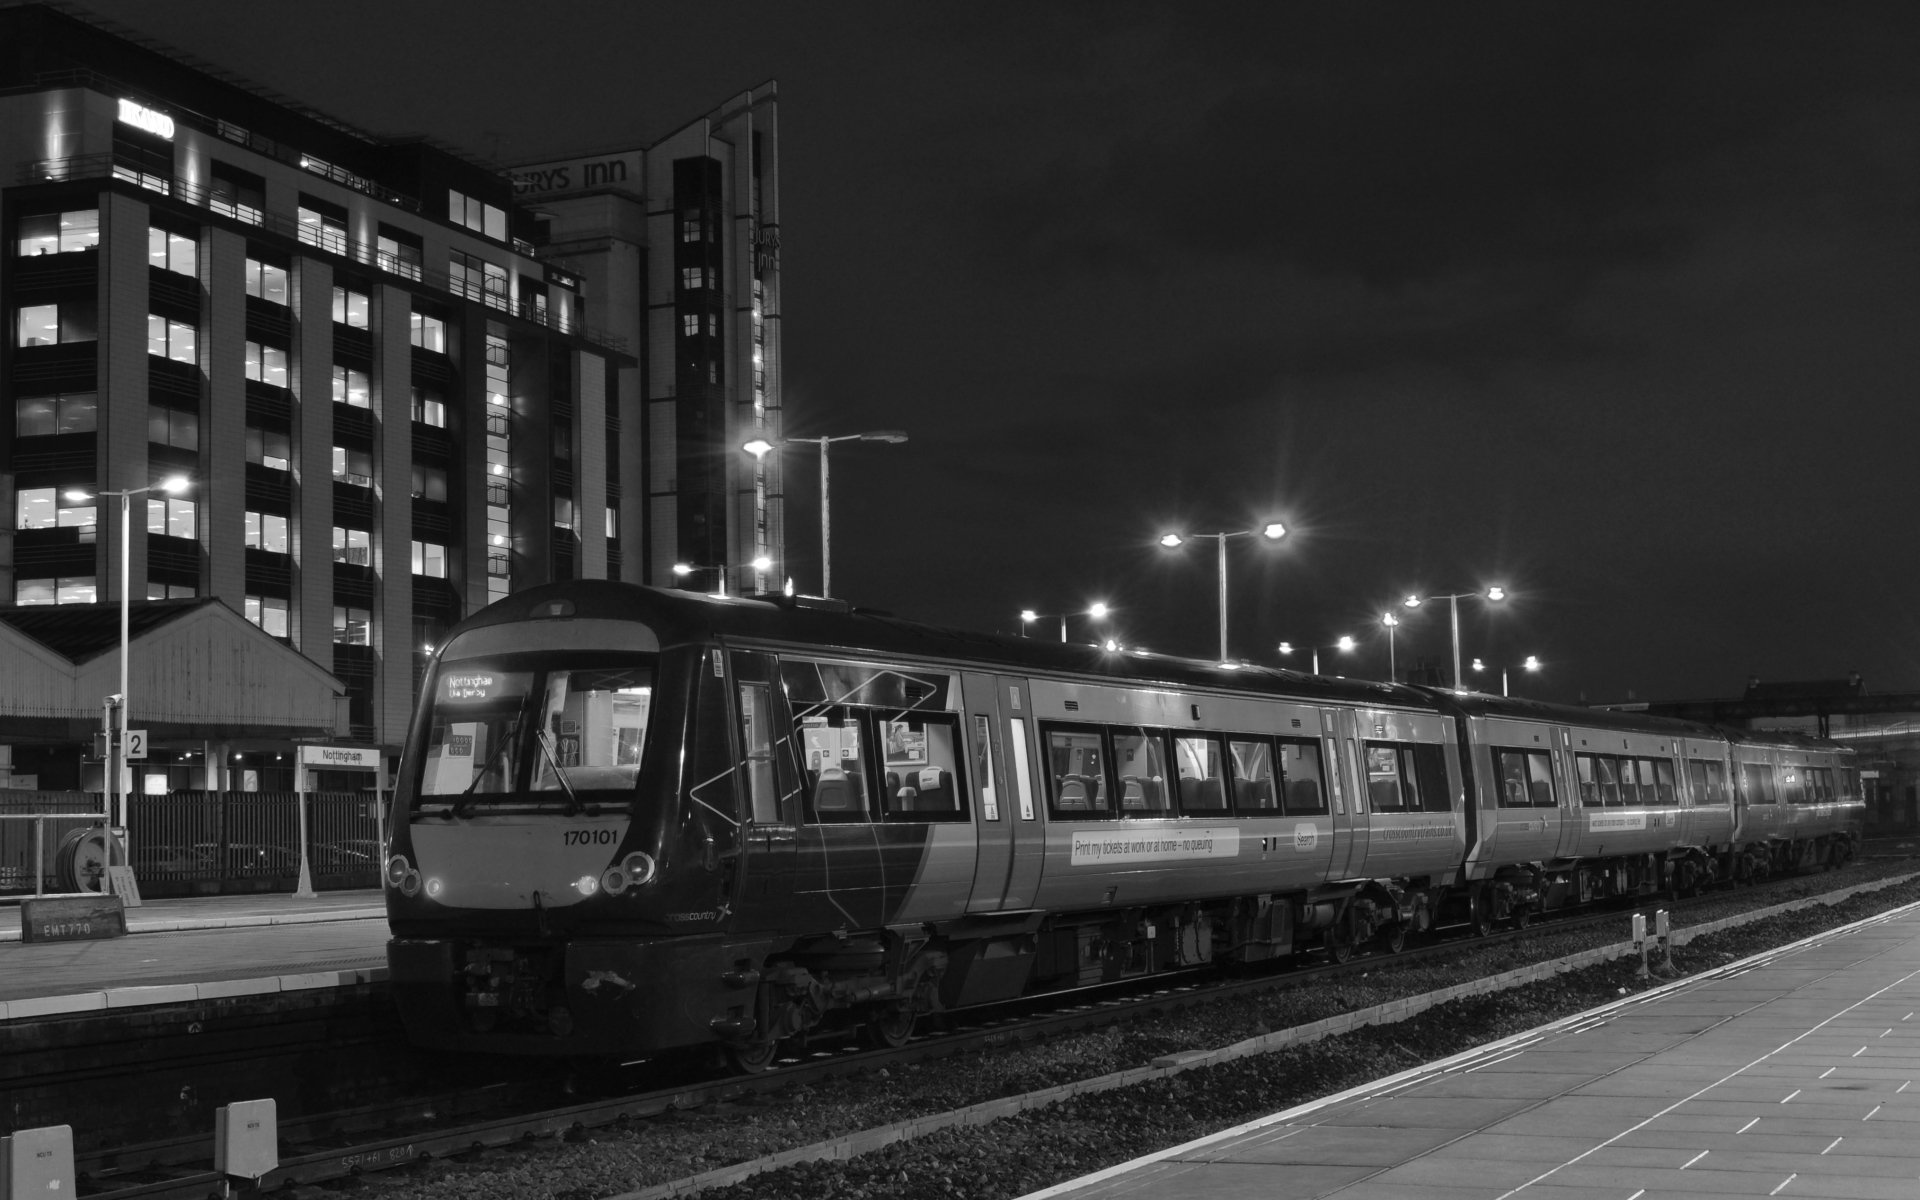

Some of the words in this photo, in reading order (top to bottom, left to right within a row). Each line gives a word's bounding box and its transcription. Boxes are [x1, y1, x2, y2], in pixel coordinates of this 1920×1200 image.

[131, 734, 141, 754] 2
[322, 749, 363, 763] Nottingham
[563, 830, 617, 846] 170101
[1297, 833, 1315, 847] Search
[1075, 840, 1091, 856] Print
[1092, 842, 1102, 858] my
[1103, 839, 1123, 855] tickets
[1124, 840, 1130, 853] at
[1131, 838, 1146, 853] work
[1147, 841, 1153, 852] or
[1154, 839, 1160, 852] at
[1161, 838, 1177, 852] home
[1183, 840, 1190, 851] no
[1191, 838, 1213, 853] queuing
[43, 922, 91, 937] EMT770
